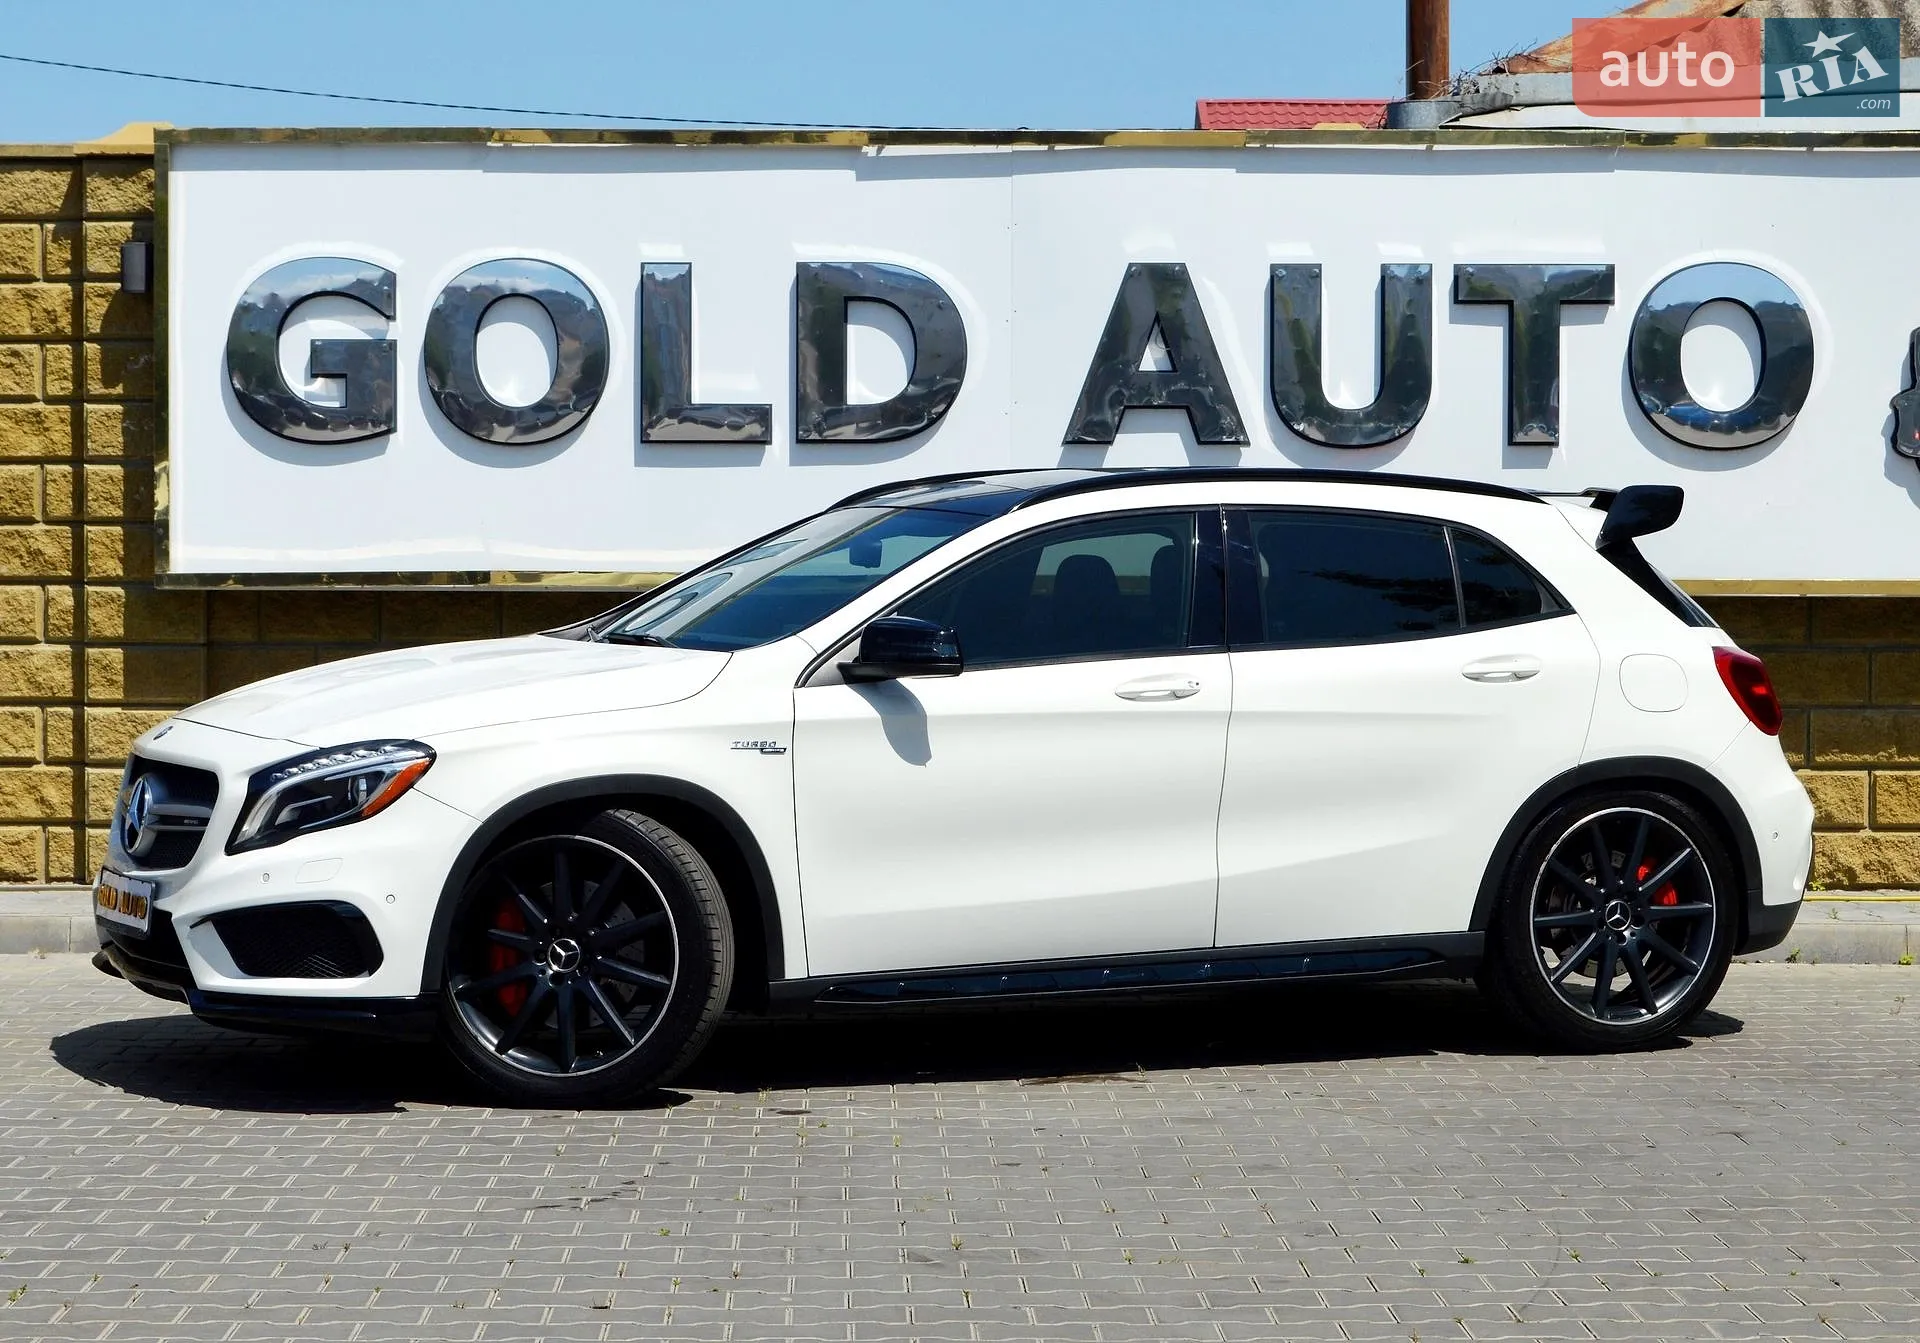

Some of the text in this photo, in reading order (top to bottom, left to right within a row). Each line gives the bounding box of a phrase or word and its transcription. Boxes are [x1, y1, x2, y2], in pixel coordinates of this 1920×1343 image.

[226, 257, 967, 446] GOLD
[1063, 261, 1815, 451] AUTO
[731, 740, 777, 748] TURBO
